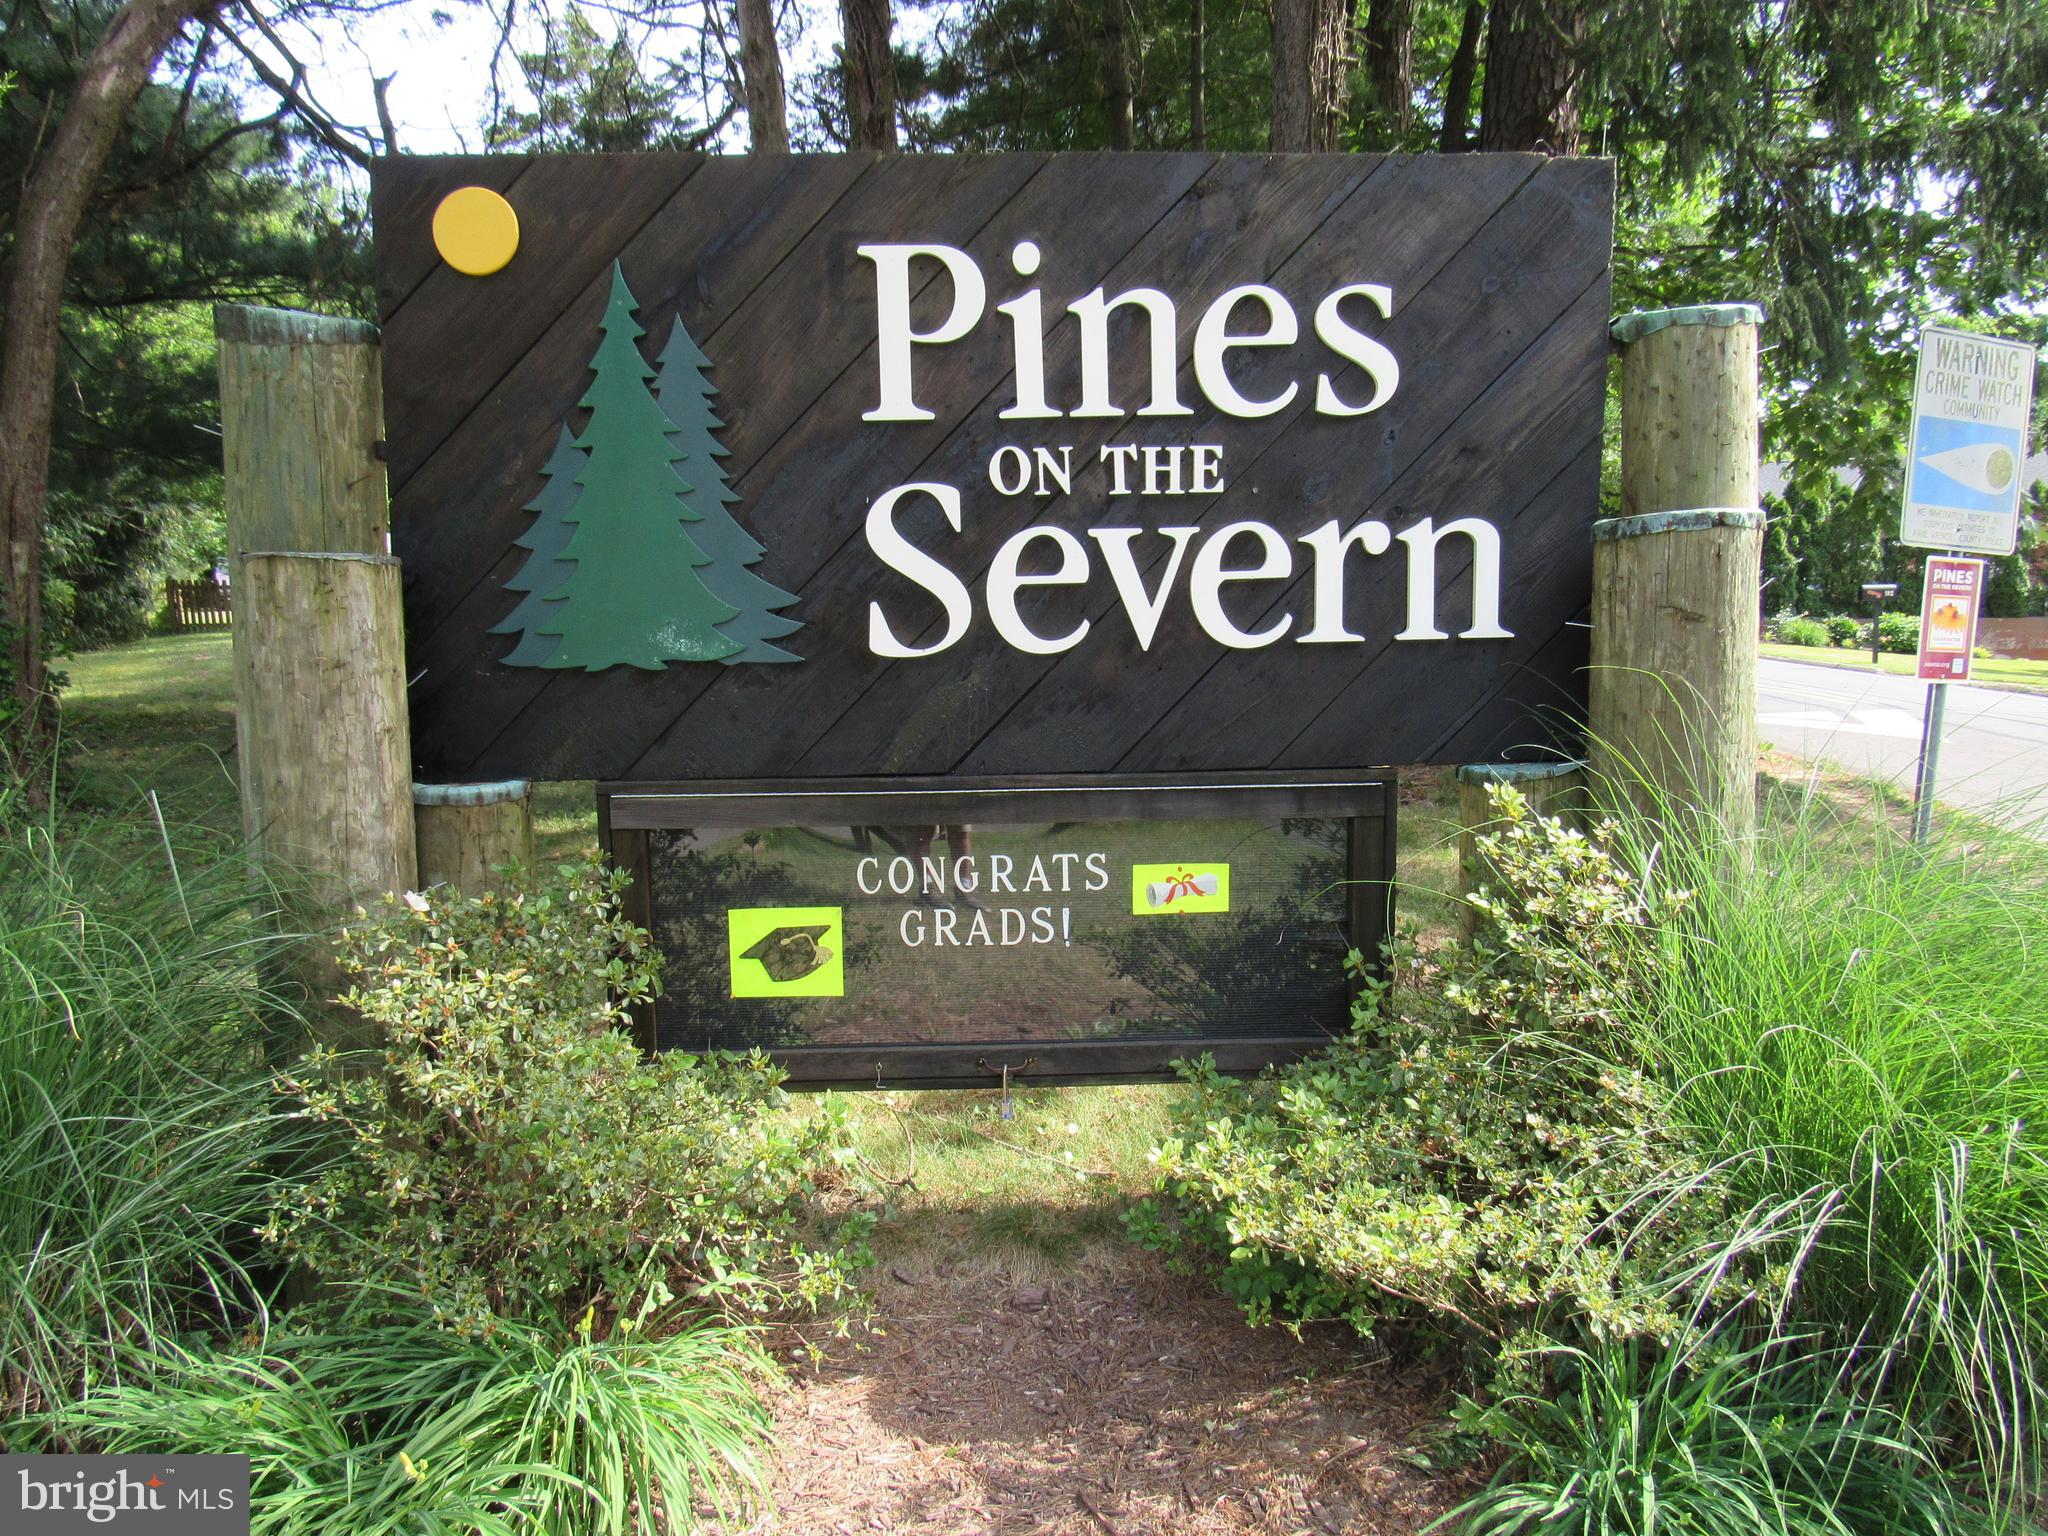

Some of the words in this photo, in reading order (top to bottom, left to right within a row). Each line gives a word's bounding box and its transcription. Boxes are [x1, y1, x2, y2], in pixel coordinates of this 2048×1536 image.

[857, 242, 1399, 420] Pines
[1937, 337, 2019, 381] WARNING
[1926, 370, 1971, 399] CRIME
[1979, 379, 2023, 408] WATCH
[1943, 399, 2001, 420] COMMUNITY
[989, 446, 1073, 495] ON
[1101, 443, 1224, 494] THE
[866, 483, 1514, 657] Severn
[1933, 568, 1973, 584] PINES
[857, 853, 1108, 894] CONGRATS
[900, 905, 1070, 947] GRADS!
